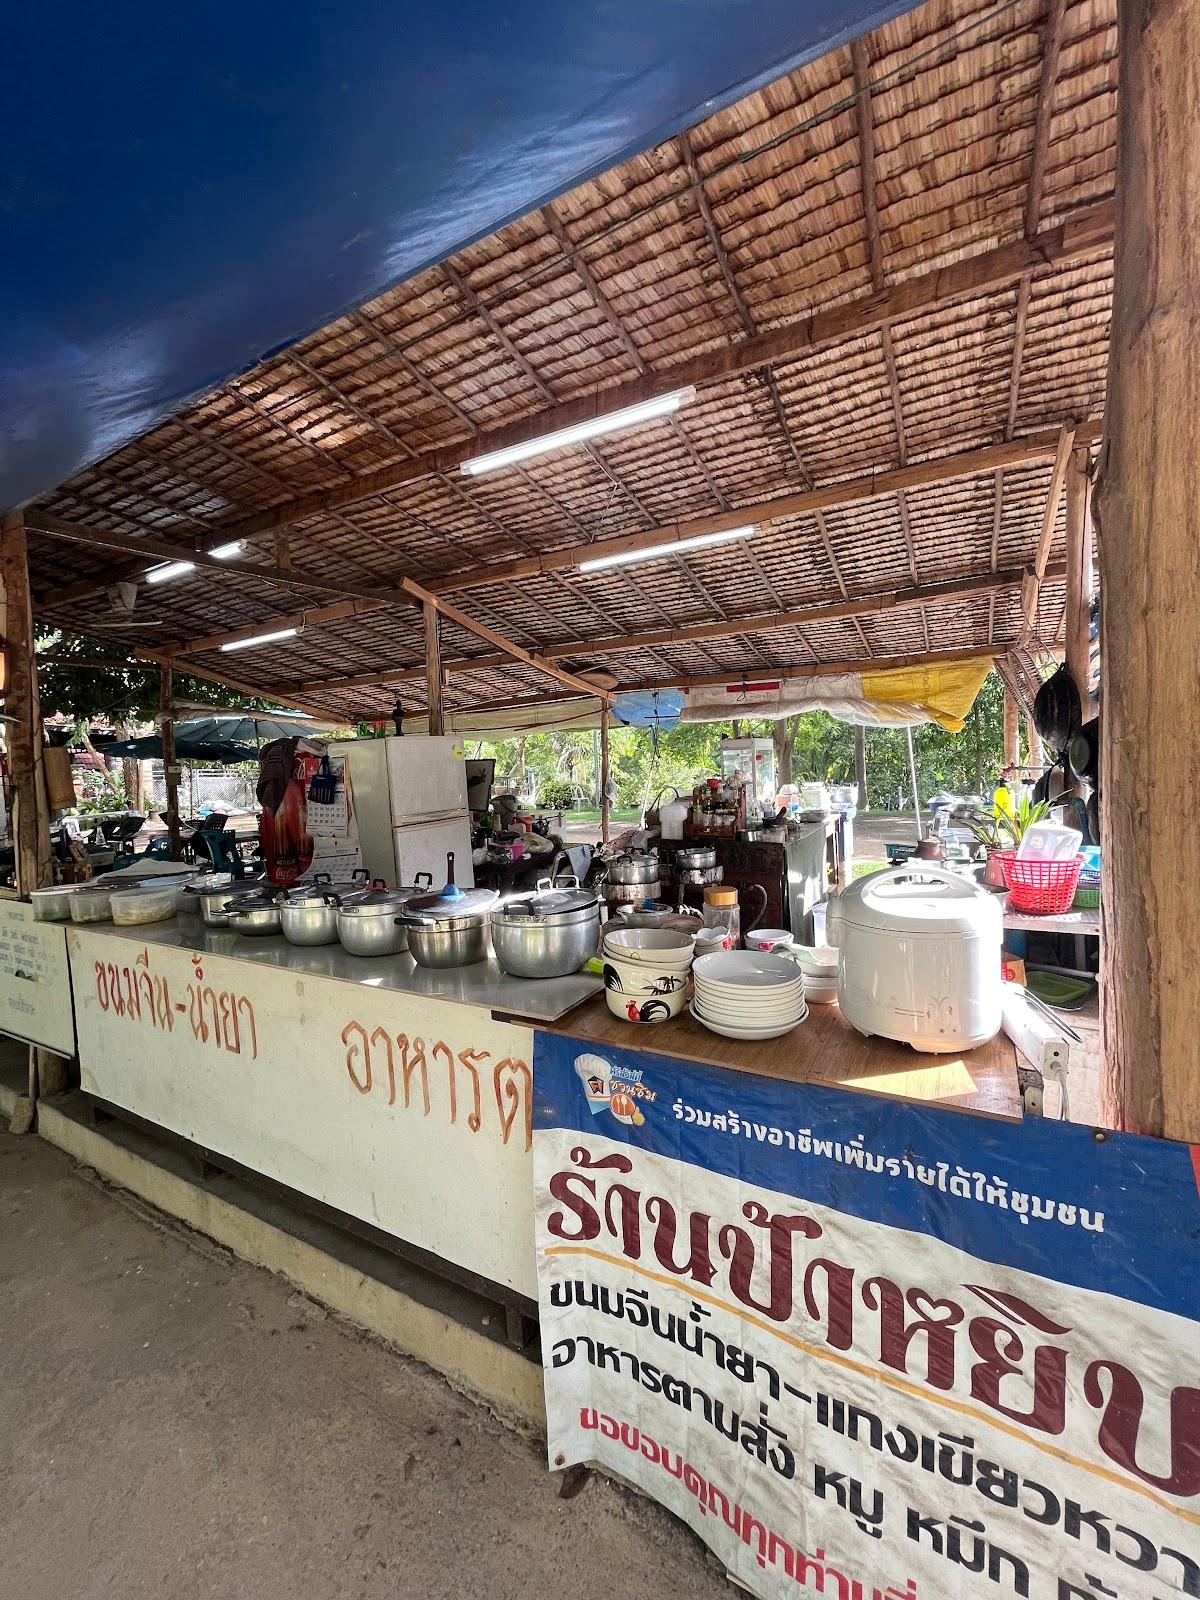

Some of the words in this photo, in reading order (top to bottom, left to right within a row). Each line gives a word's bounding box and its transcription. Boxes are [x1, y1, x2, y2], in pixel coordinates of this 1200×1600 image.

[672, 1098, 1105, 1233] ร่วมสร้างอาชีพเพิ่มรายได้ให้ชุมชน
[552, 1336, 796, 1480] อาหารตามสั่ง
[814, 1463, 884, 1539] หมู
[906, 1507, 1030, 1599] หมึก
